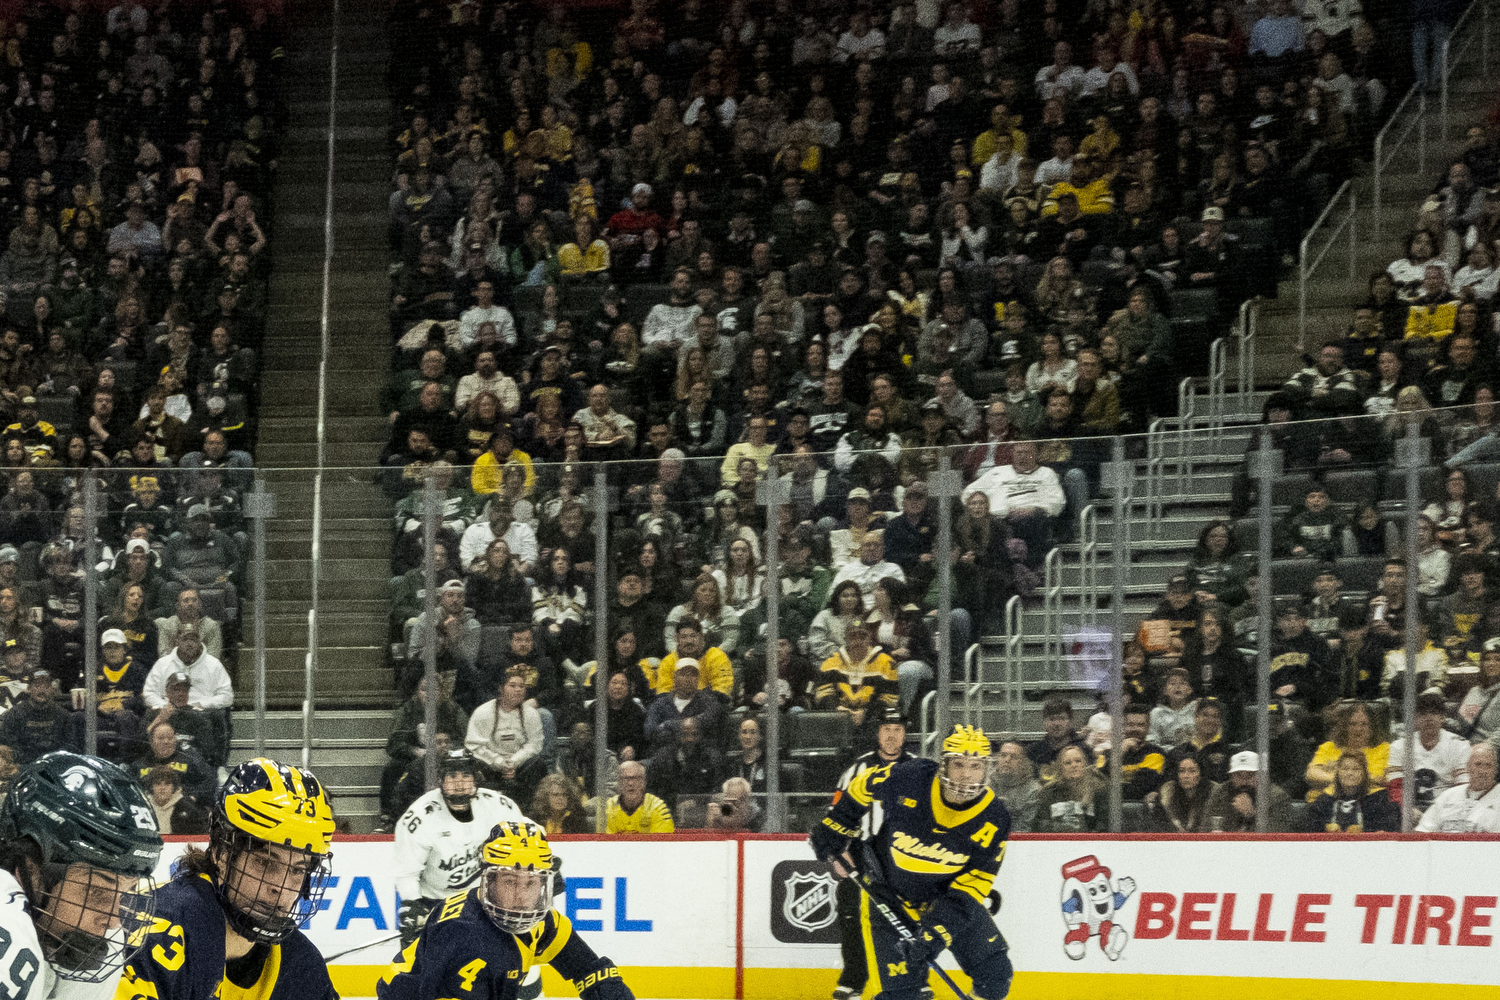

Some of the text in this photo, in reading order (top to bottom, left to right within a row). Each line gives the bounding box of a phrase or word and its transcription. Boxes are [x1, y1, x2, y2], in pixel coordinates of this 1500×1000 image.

[129, 804, 157, 831] 29
[293, 796, 317, 819] 73
[520, 836, 530, 848] 4
[970, 821, 999, 848] A
[795, 887, 829, 918] NHL
[1133, 892, 1498, 948] BELLE TIRE
[457, 957, 488, 992] 4
[575, 966, 622, 994] BAUE
[886, 960, 909, 977] M
